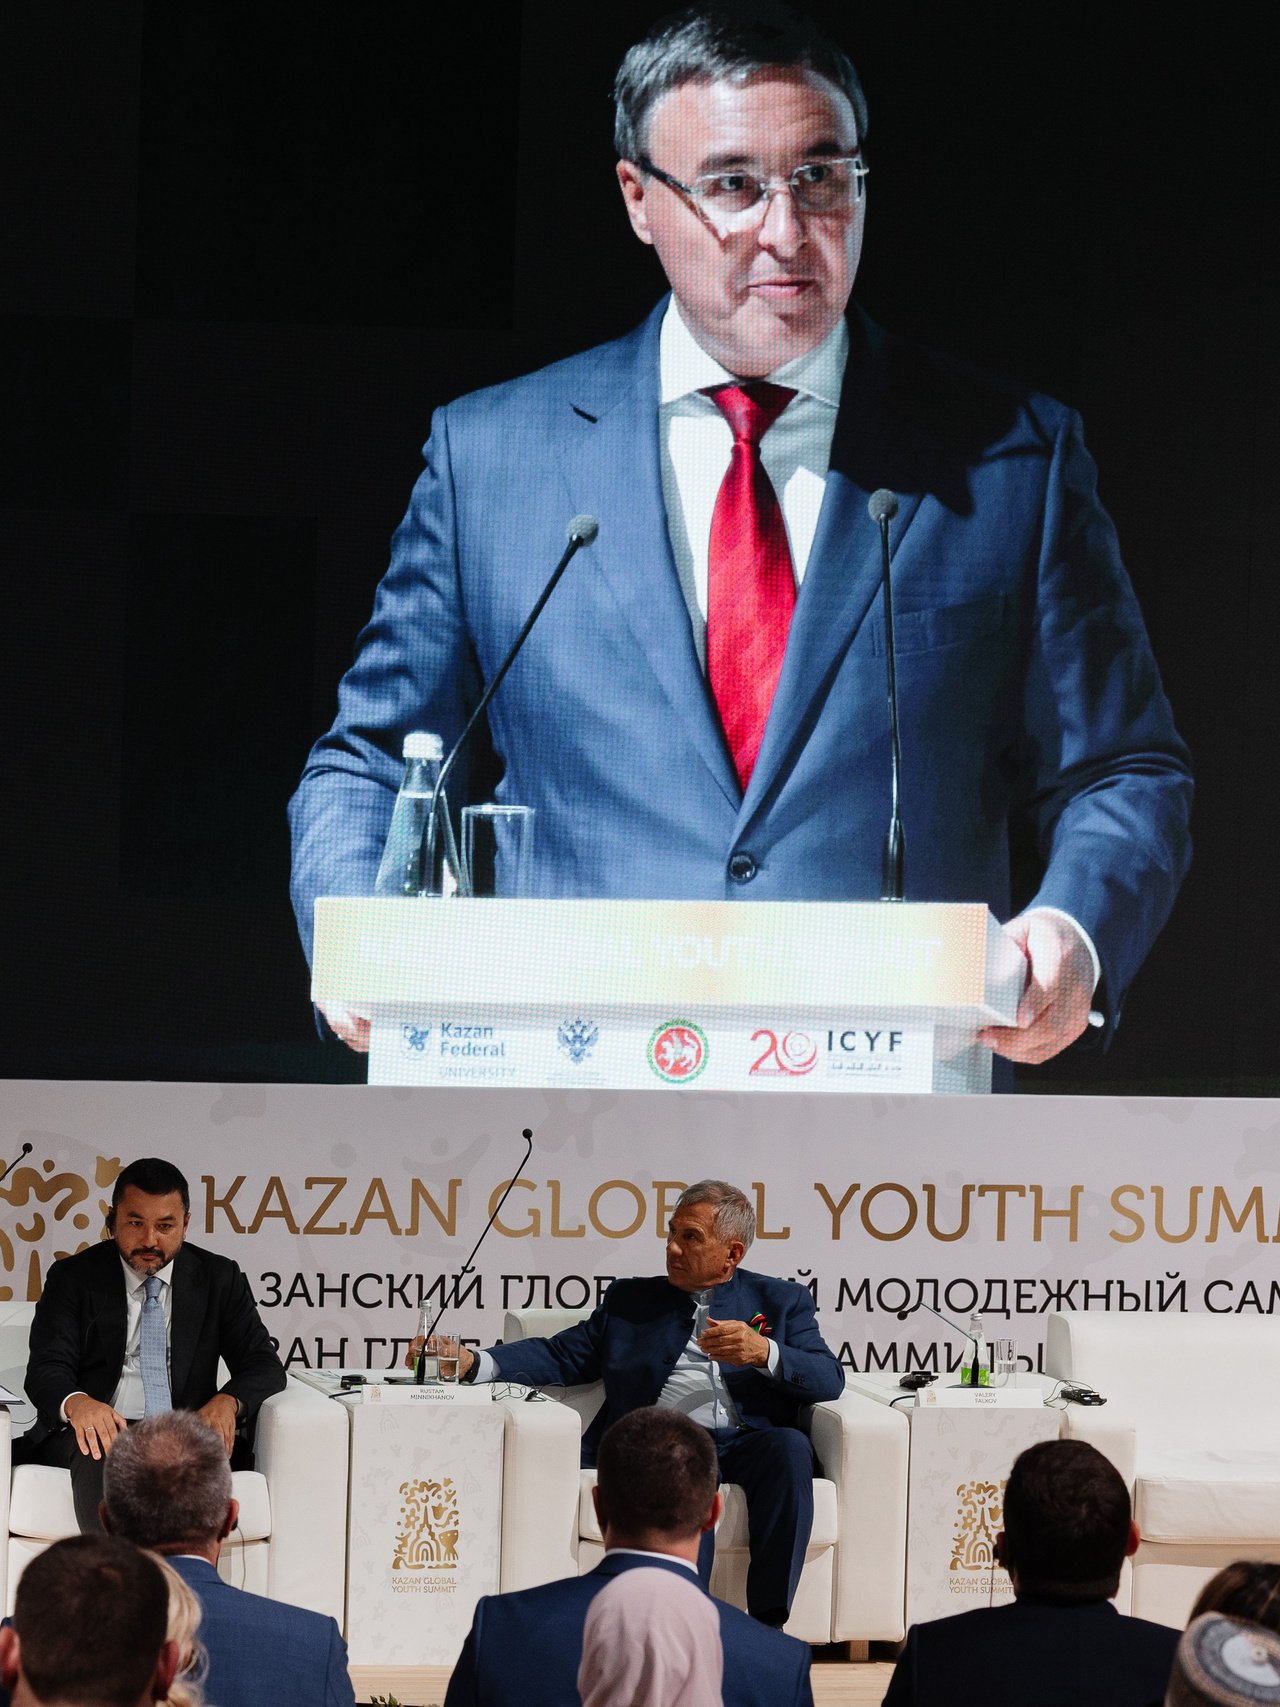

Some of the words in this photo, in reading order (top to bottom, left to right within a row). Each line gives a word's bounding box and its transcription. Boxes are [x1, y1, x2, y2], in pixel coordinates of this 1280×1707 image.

[441, 1022, 493, 1039] Kazan
[827, 1030, 903, 1052] ICYF
[440, 1042, 505, 1057] Federal
[439, 1066, 515, 1079] UNIVERSITY
[201, 1174, 463, 1237] KAZAN
[487, 1178, 791, 1240] GLOBL
[814, 1181, 1085, 1243] YOUTH
[1108, 1184, 1280, 1244] SUM
[834, 1270, 1189, 1320] МОЛОДЕЖНЫЙ
[392, 1577, 422, 1585] KAZAN
[423, 1577, 457, 1585] GLOBAL
[949, 1577, 978, 1586] KAZAN
[392, 1585, 422, 1594] YOUTH
[423, 1585, 457, 1594] SUMMIT
[949, 1586, 978, 1594] YOUTH
